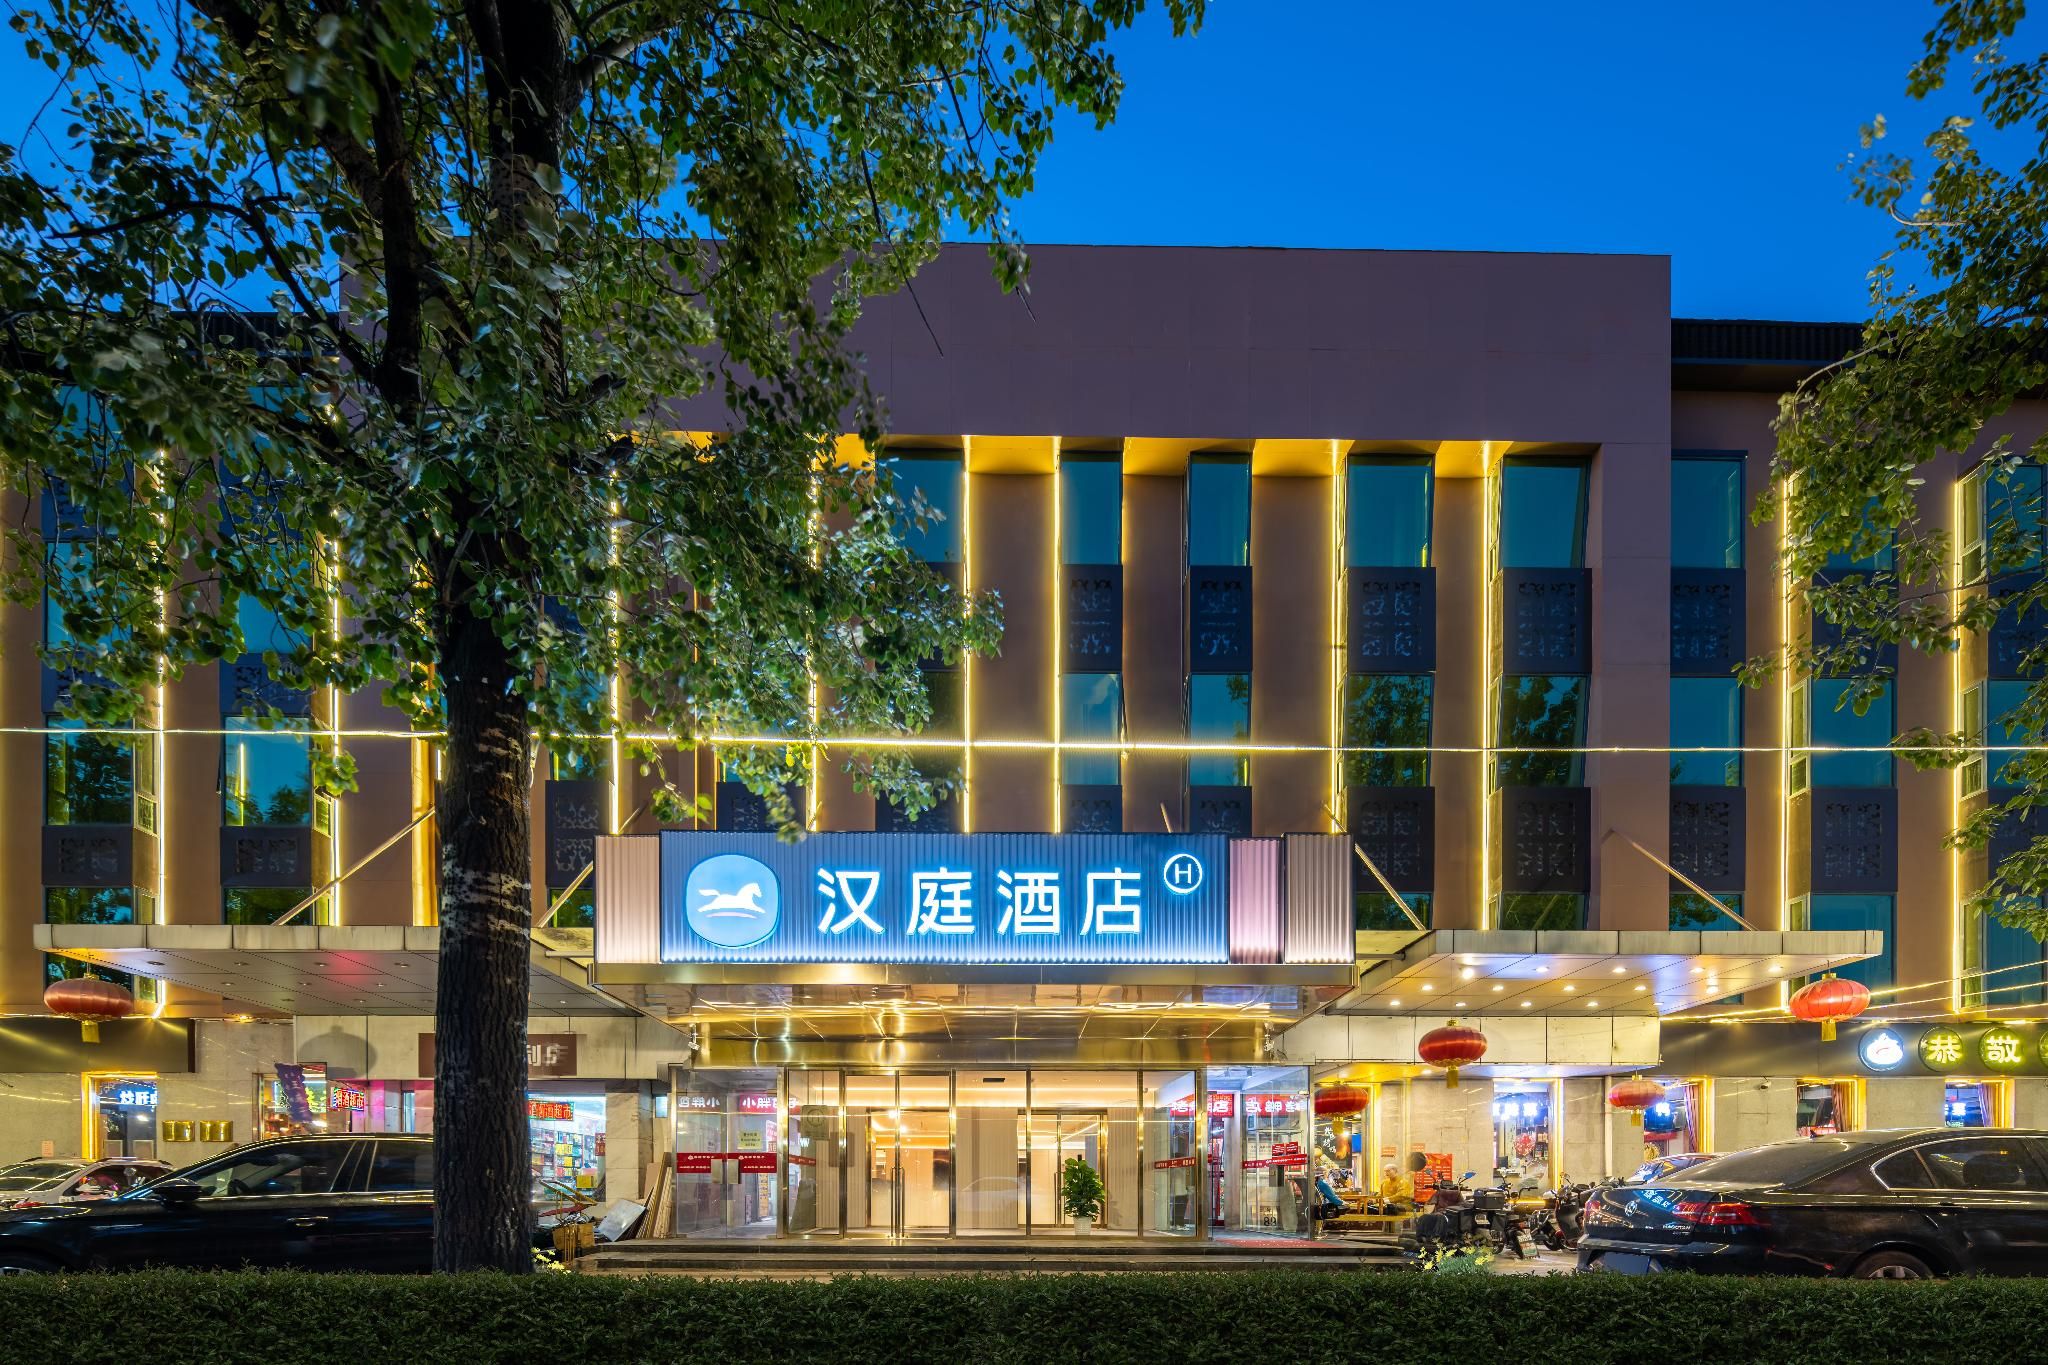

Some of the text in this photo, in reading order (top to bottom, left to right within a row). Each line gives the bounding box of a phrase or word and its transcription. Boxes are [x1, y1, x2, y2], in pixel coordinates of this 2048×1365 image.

[817, 867, 1141, 935] 汉庭酒店
[1926, 1034, 2048, 1063] 恭敬
